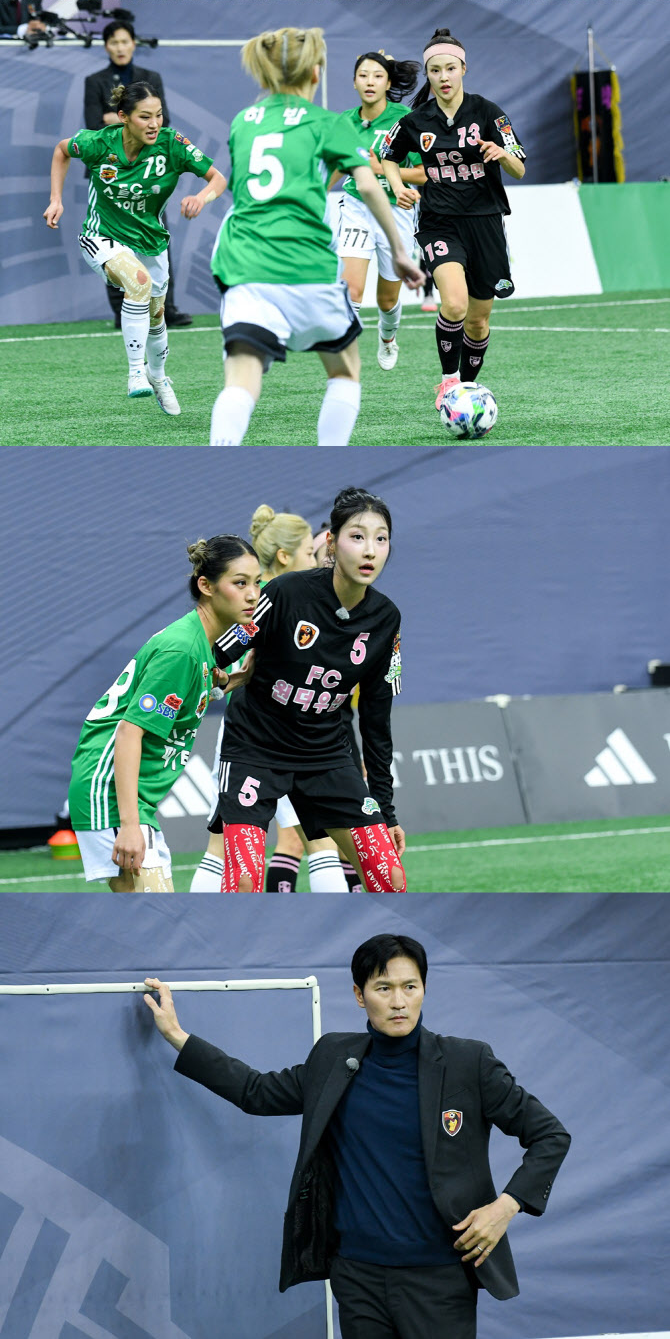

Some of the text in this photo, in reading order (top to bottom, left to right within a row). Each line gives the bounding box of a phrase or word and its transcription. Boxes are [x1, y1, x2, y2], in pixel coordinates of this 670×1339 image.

[457, 122, 481, 148] 13
[142, 155, 167, 180] 78
[246, 132, 285, 201] 5
[435, 150, 464, 166] FC
[427, 162, 486, 183] 원더우먼
[343, 227, 369, 249] 777
[424, 241, 449, 262] 13
[350, 632, 370, 665] 5
[305, 665, 342, 689] FC
[271, 679, 349, 715] 원더우먼
[155, 703, 177, 720] SBS
[412, 744, 504, 786] THIS
[237, 775, 261, 807] 5
